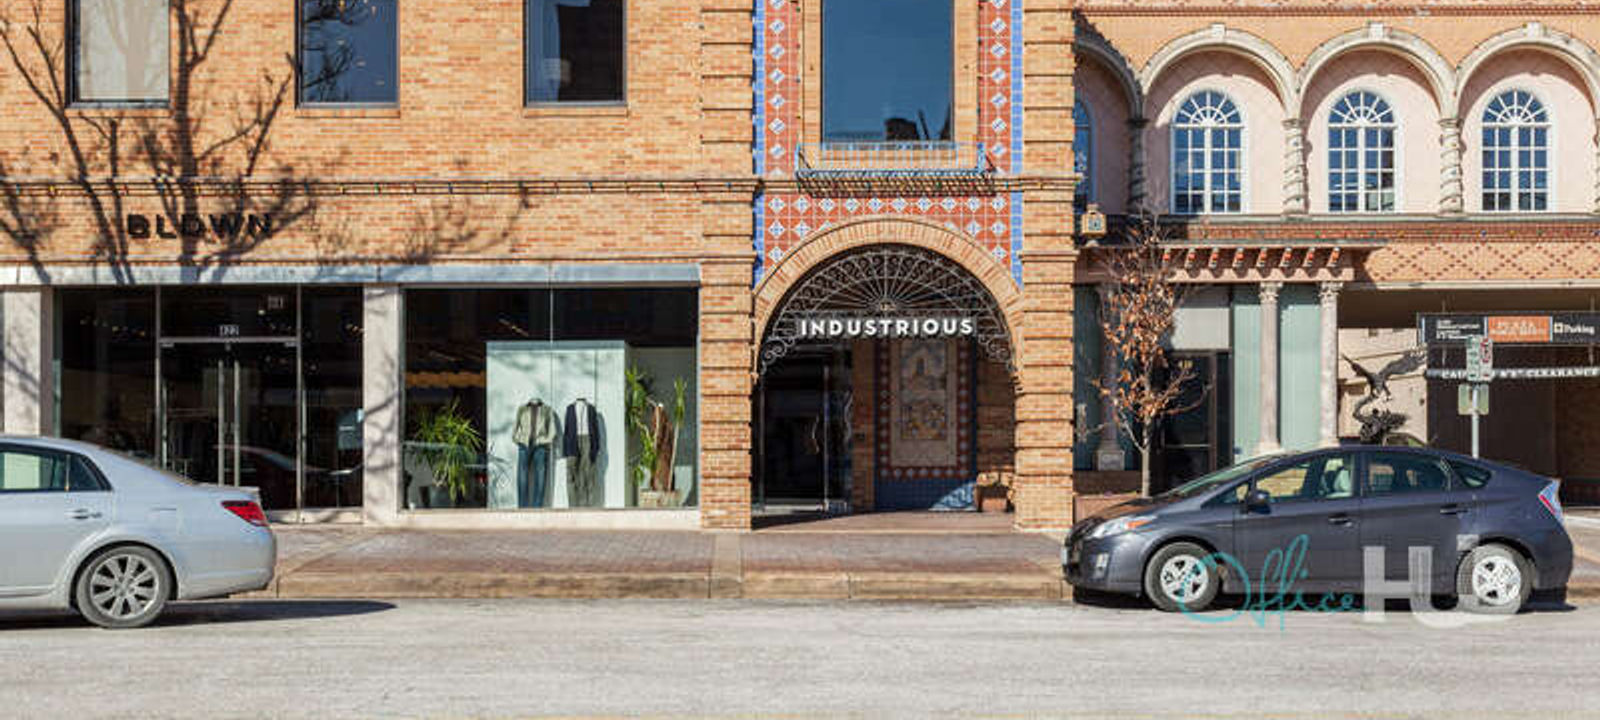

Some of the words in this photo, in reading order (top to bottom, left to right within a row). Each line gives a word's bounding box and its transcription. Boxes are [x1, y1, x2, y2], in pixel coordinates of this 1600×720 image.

[799, 318, 974, 338] INDUSTRIOUS
[1564, 322, 1595, 335] Parking
[1526, 366, 1599, 378] CLEARANCE
